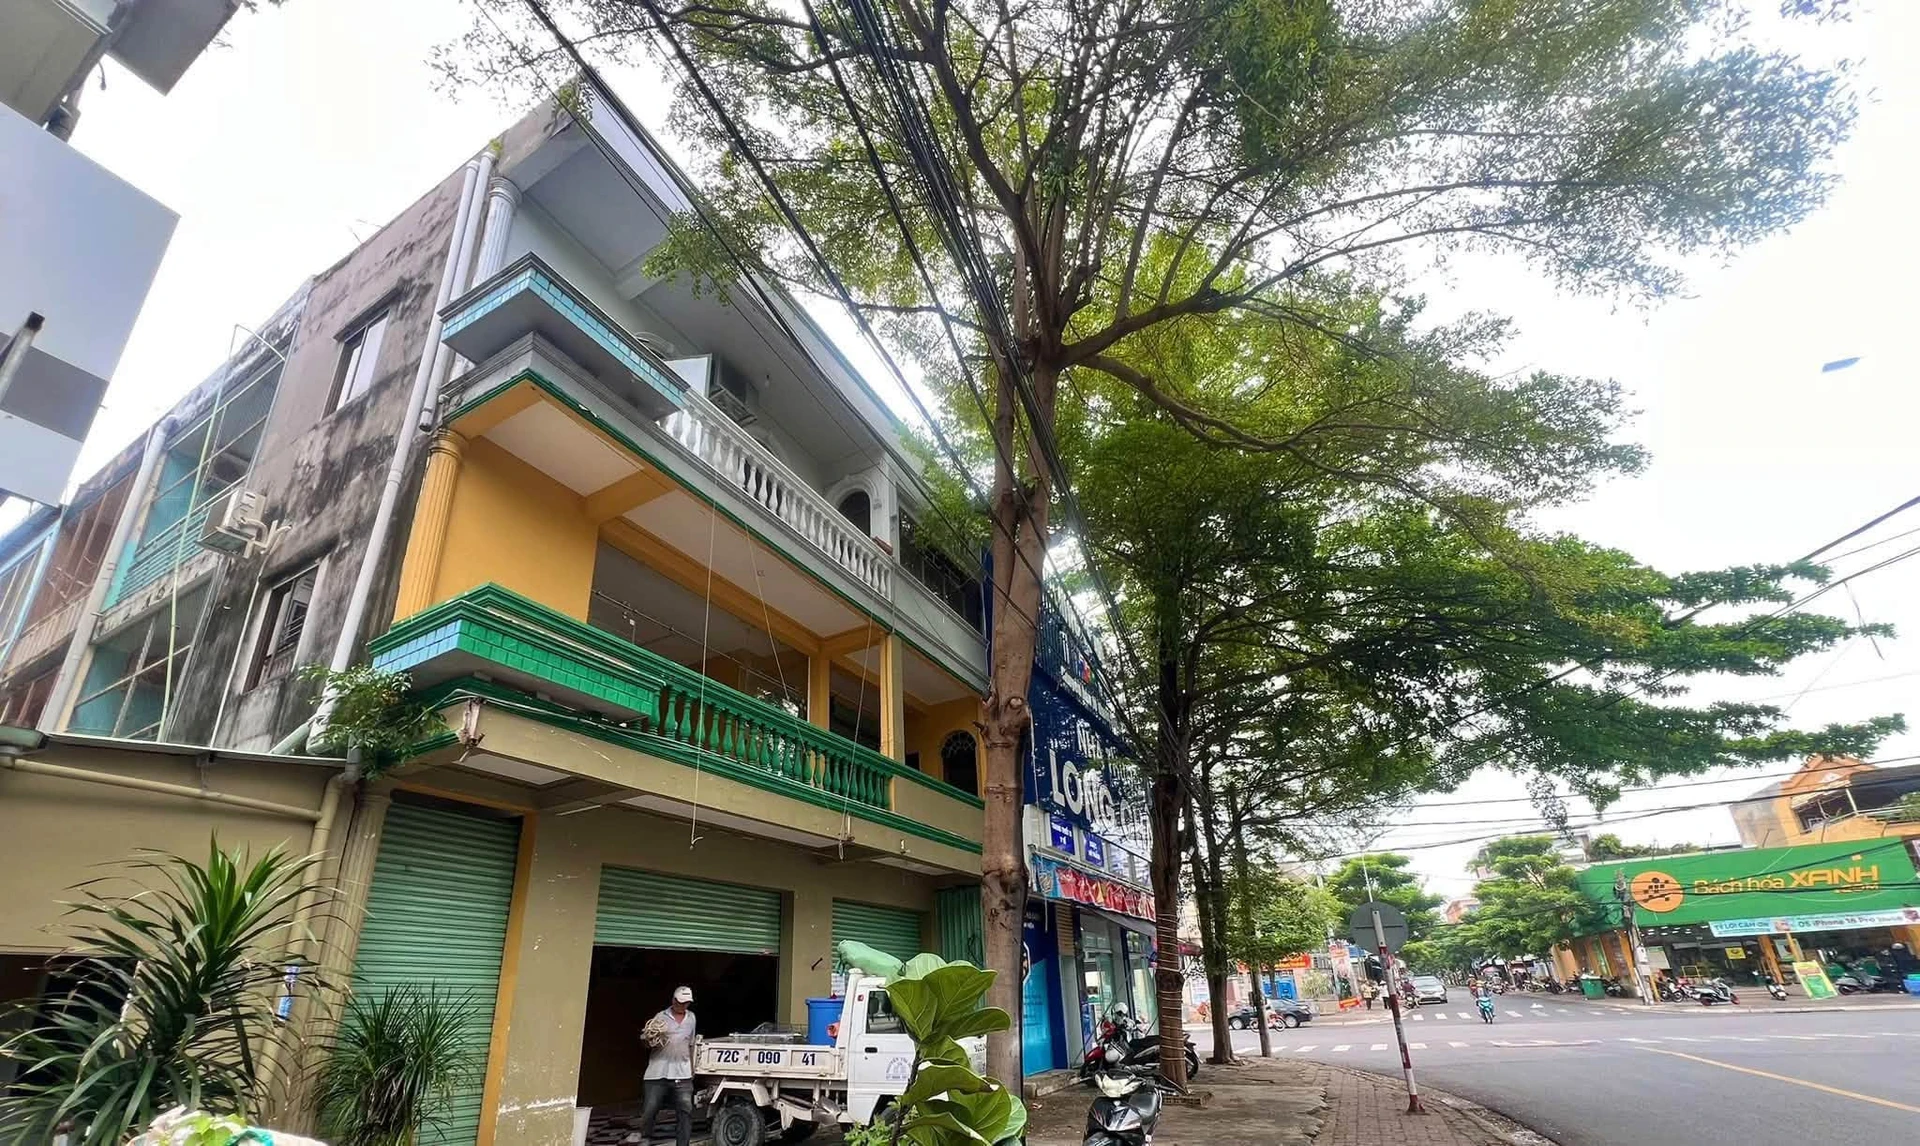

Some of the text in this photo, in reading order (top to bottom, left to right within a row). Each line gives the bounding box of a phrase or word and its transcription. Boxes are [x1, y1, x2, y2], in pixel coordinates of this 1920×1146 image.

[1049, 748, 1115, 831] LONG
[1747, 874, 1785, 891] hóa
[1789, 865, 1879, 887] XANH
[717, 1050, 816, 1066] 72C 090 41
